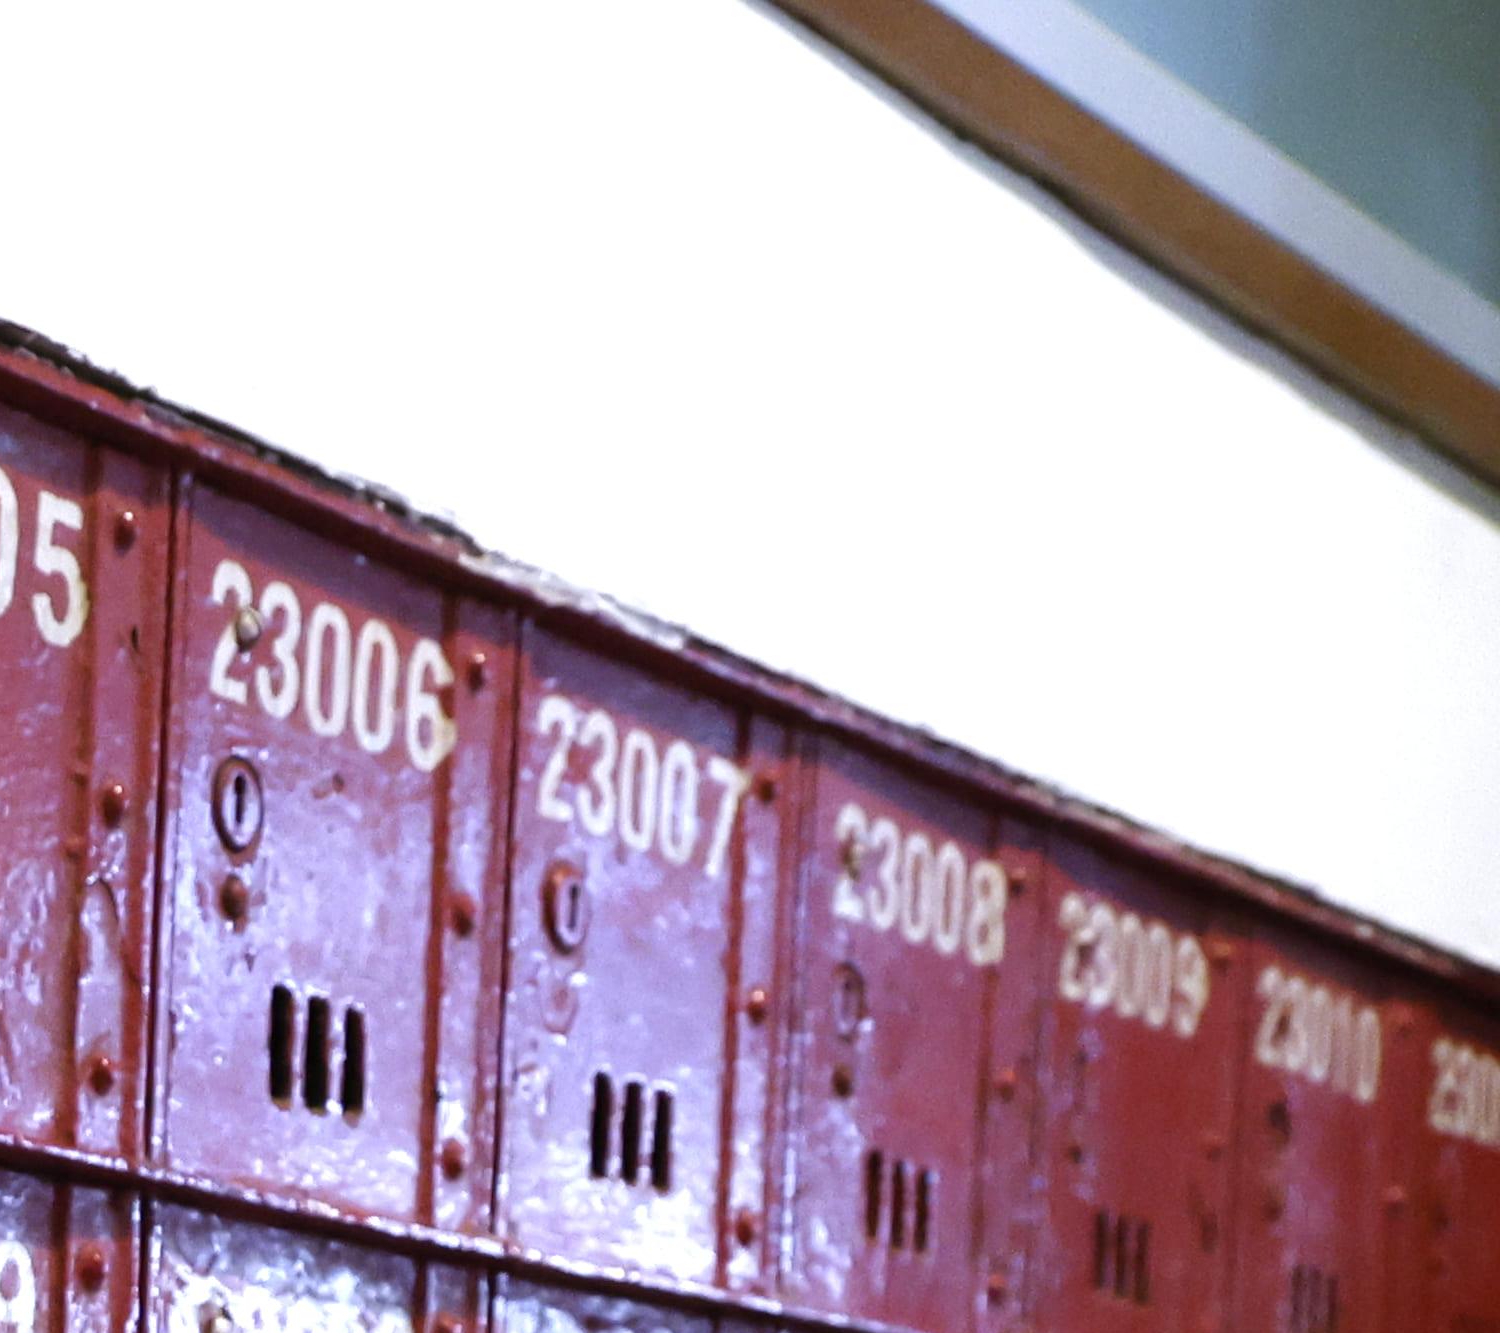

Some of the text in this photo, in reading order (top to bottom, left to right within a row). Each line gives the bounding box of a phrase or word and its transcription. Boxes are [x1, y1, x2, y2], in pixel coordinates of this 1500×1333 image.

[210, 561, 456, 772] 23006
[536, 697, 746, 876] 23007
[832, 803, 1005, 964] 23008
[1059, 893, 1207, 1035] 23009
